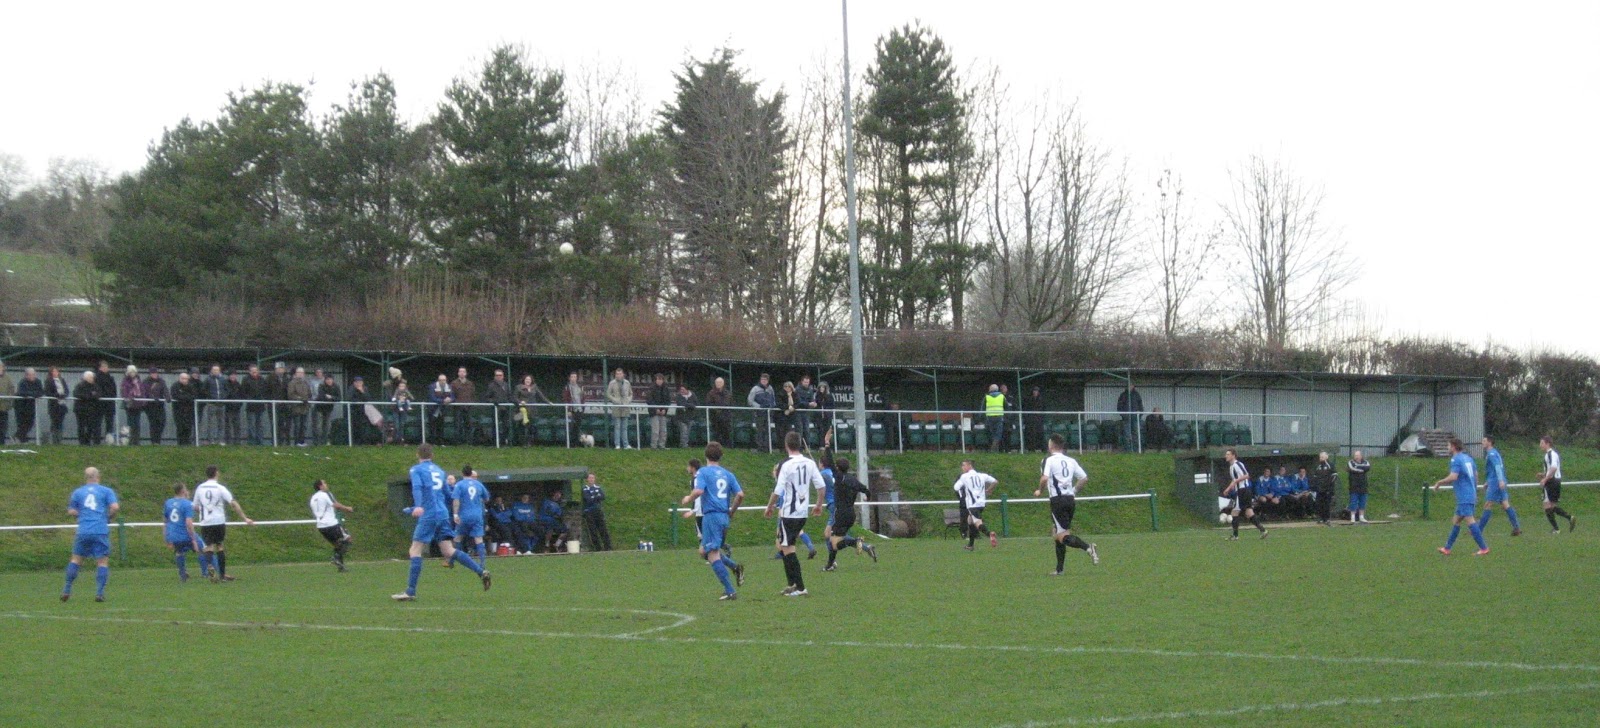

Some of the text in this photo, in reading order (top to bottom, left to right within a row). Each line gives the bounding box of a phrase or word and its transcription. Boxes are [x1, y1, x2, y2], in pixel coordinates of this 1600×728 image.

[868, 393, 883, 403] F.C.
[796, 464, 807, 485] 11
[1060, 460, 1070, 478] 8
[431, 472, 443, 490] 5
[716, 478, 728, 499] 2
[970, 475, 981, 489] 10
[205, 489, 213, 504] 9
[468, 486, 477, 500] 9
[84, 494, 97, 510] 4
[169, 508, 180, 523] 6
